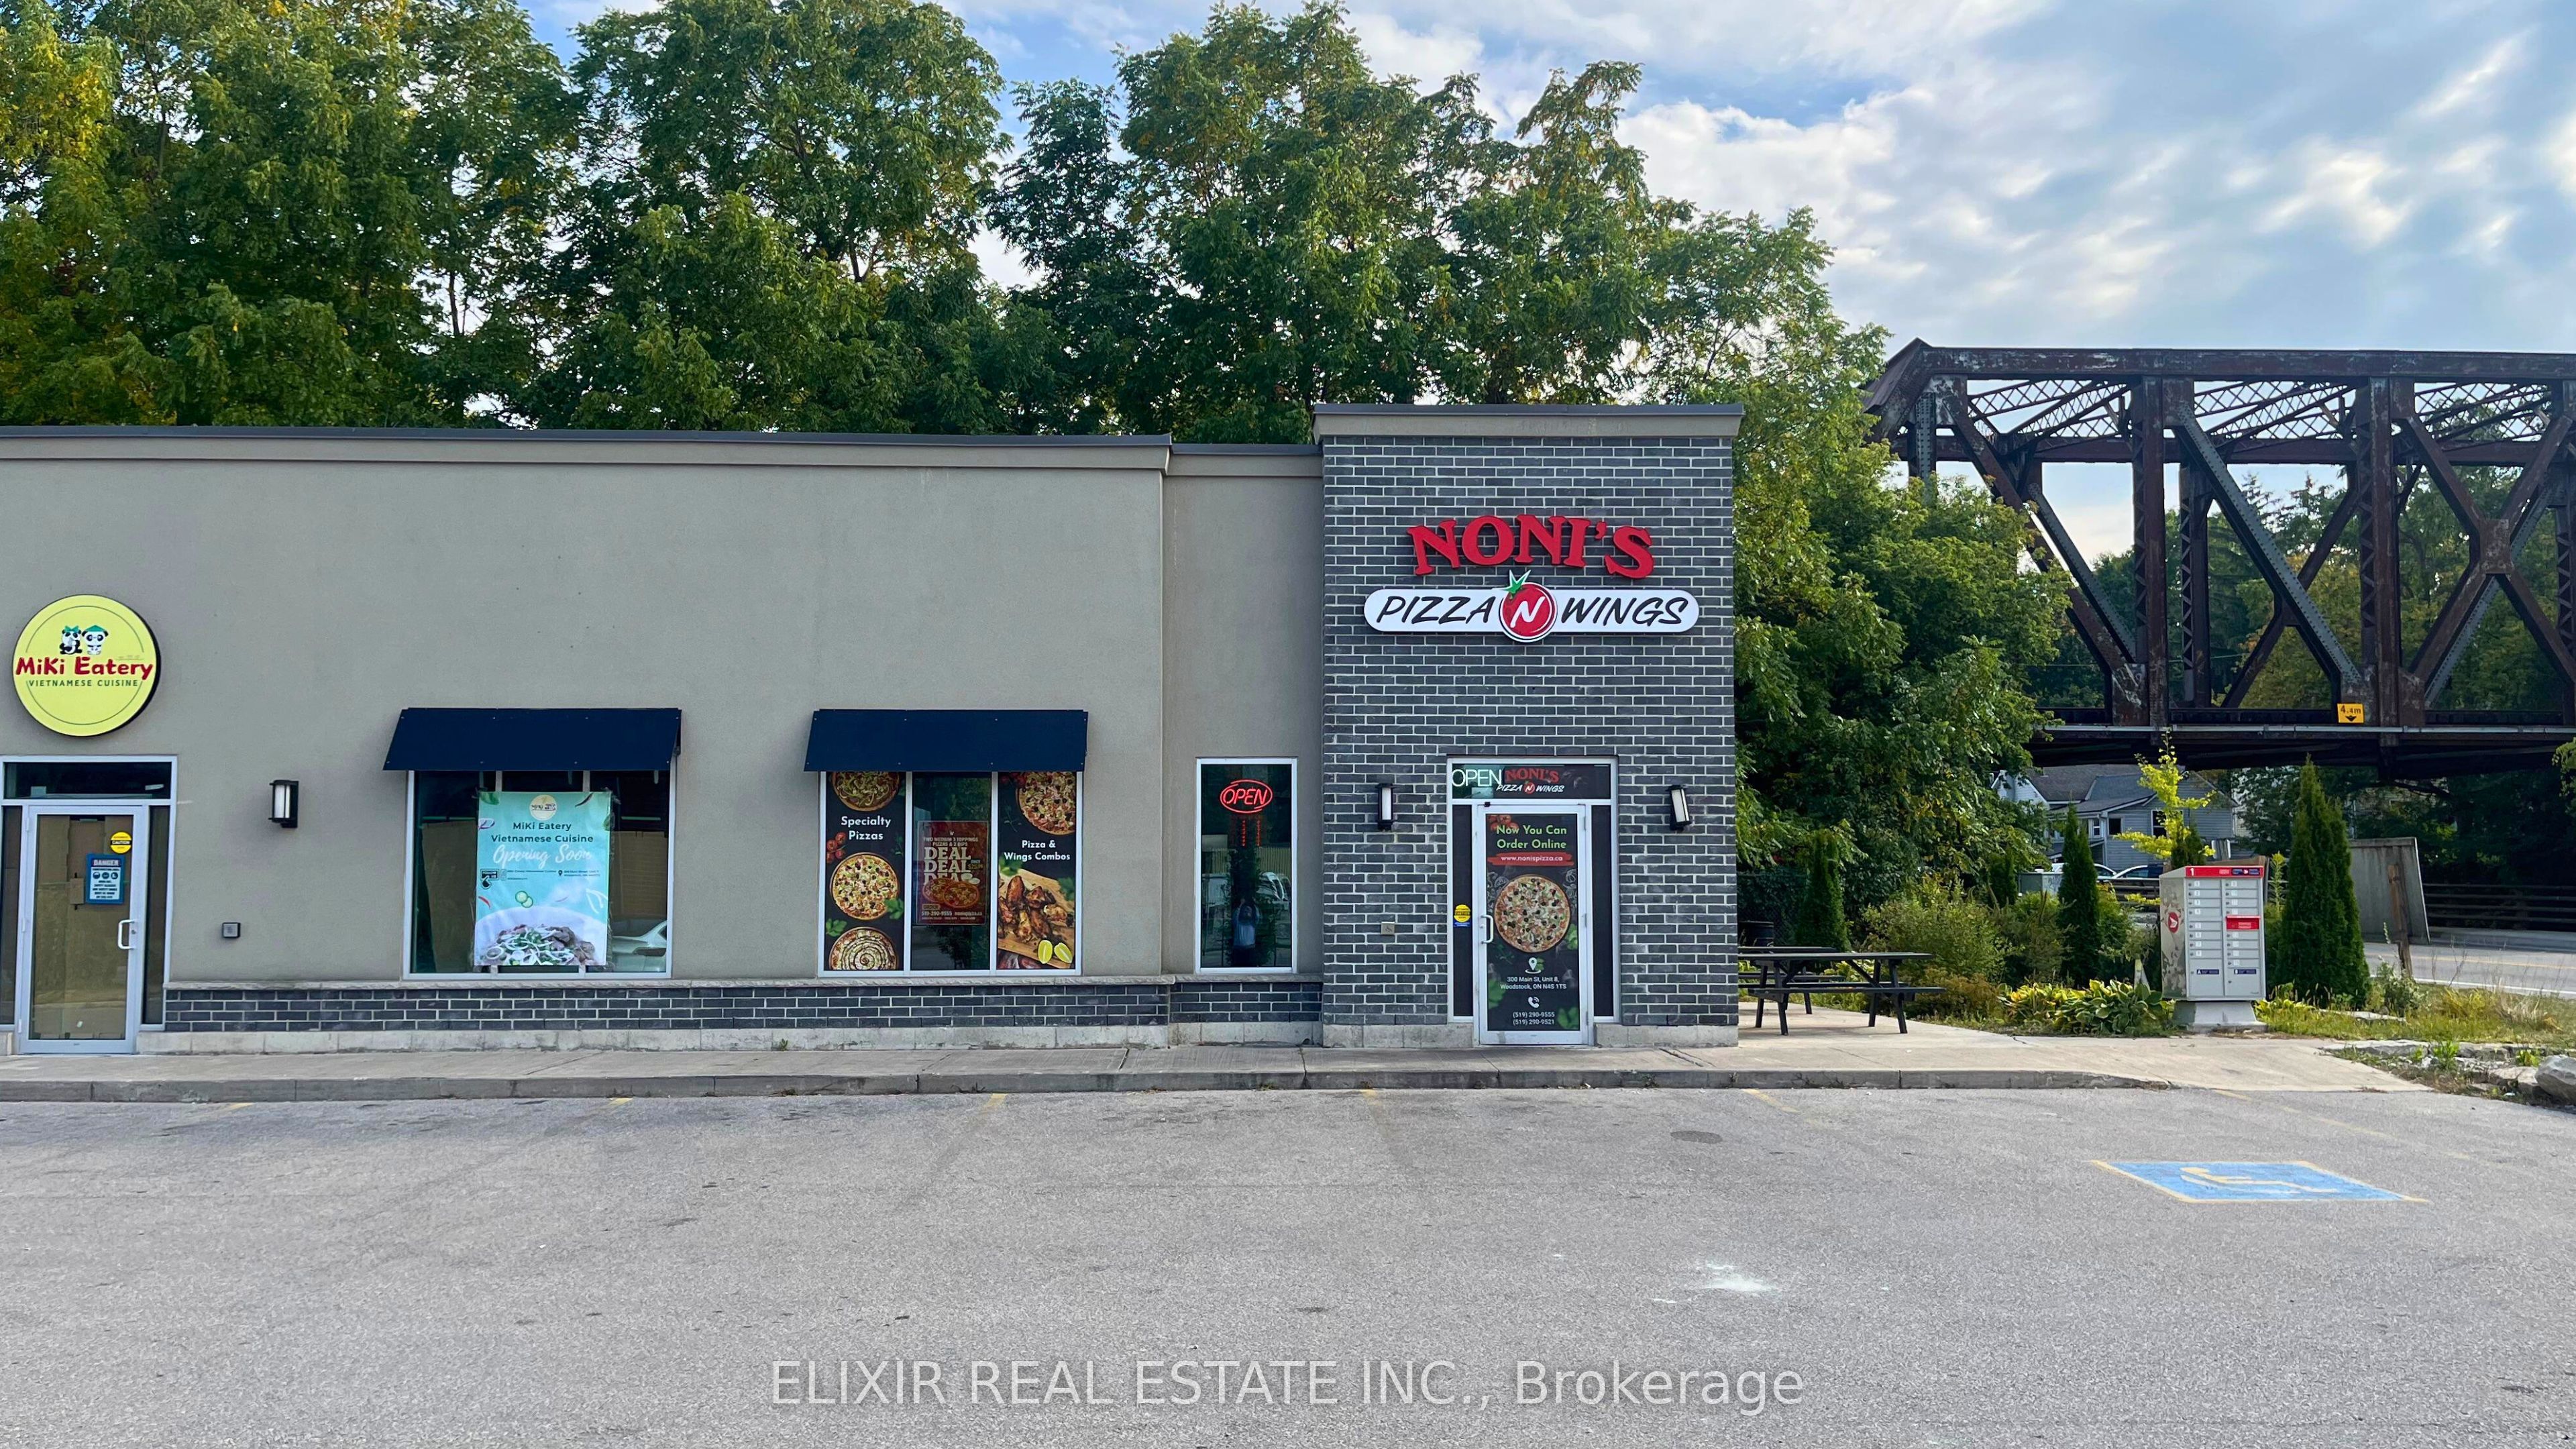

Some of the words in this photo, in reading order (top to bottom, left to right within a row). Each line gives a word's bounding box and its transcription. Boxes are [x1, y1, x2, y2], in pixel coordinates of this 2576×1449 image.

[1407, 514, 1654, 579] NONI'S
[1376, 595, 1496, 624] PIZZA
[1510, 596, 1546, 628] N
[1561, 596, 1688, 627] WINGS
[15, 657, 66, 675] MiKi
[74, 656, 154, 681] Eatery
[1451, 769, 1502, 787] OPEN
[1505, 767, 1560, 784] NONI'S
[1496, 784, 1523, 792] PIZZA
[1536, 785, 1565, 793] WINGS
[1223, 788, 1268, 805] OPEN
[539, 822, 572, 831] Eatery
[841, 816, 892, 828] Specialty
[849, 831, 883, 841] Pizzas
[1496, 825, 1519, 835] Now
[1523, 825, 1542, 835] You
[1546, 825, 1567, 835] Can
[491, 835, 551, 843] Vietnamese
[555, 835, 594, 843] Cuisine
[1021, 840, 1046, 848] Pizza
[1048, 840, 1056, 848] &
[1497, 839, 1528, 849] Order
[1532, 839, 1567, 849] Online
[492, 844, 551, 869] Opening
[555, 844, 592, 863] Soon
[924, 847, 971, 860] DEAL
[1004, 852, 1032, 862] Wings
[1035, 852, 1071, 861] Combos
[924, 860, 971, 873] DEAL
[2190, 867, 2194, 876] 1
